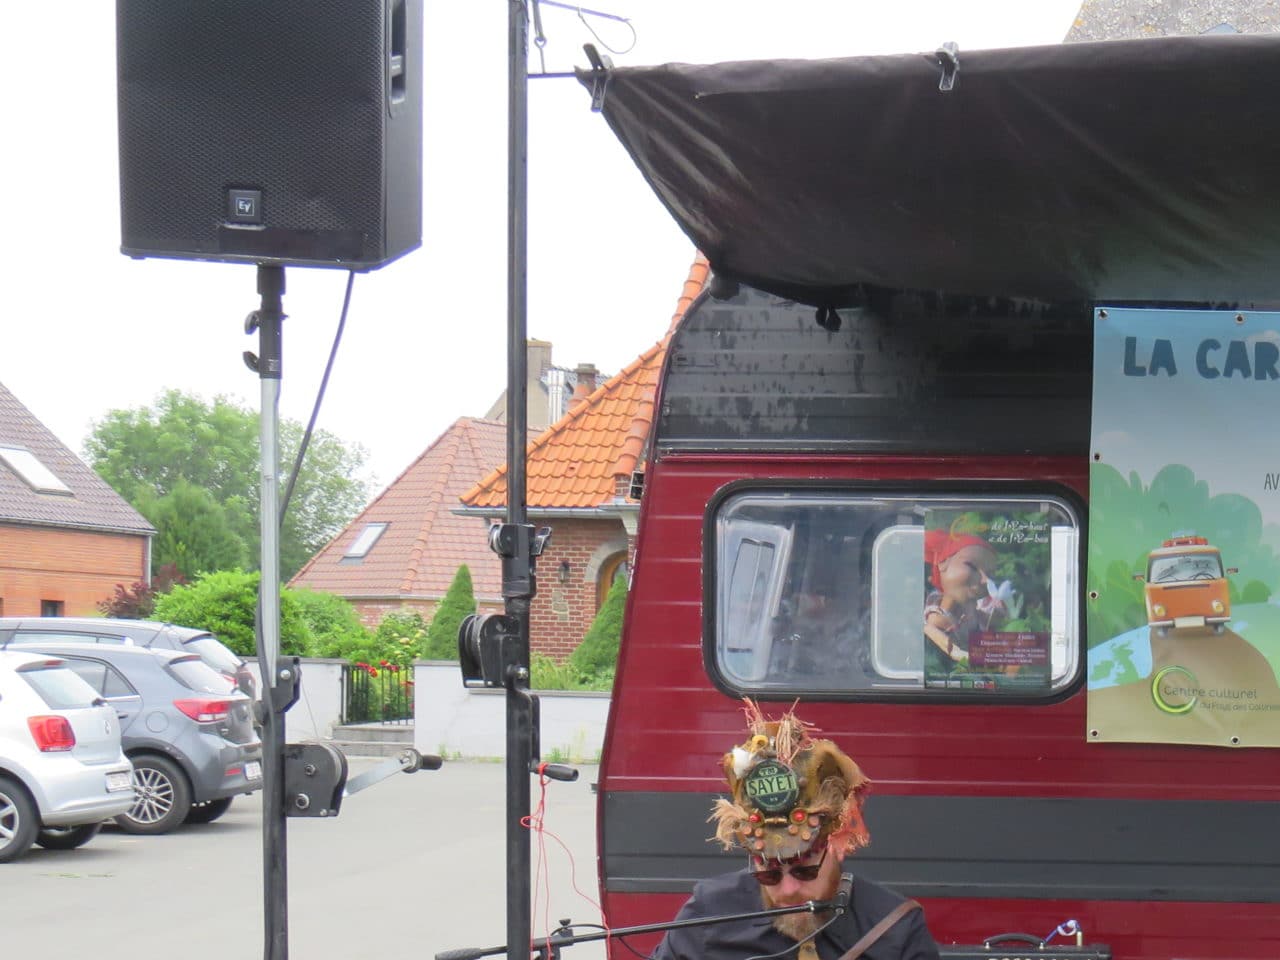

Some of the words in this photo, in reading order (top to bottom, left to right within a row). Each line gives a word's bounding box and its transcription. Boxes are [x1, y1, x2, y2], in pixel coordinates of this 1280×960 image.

[1123, 336, 1178, 377] LA
[1163, 685, 1206, 698] Centre
[1208, 687, 1258, 700] culturel
[748, 774, 793, 796] SAYET
